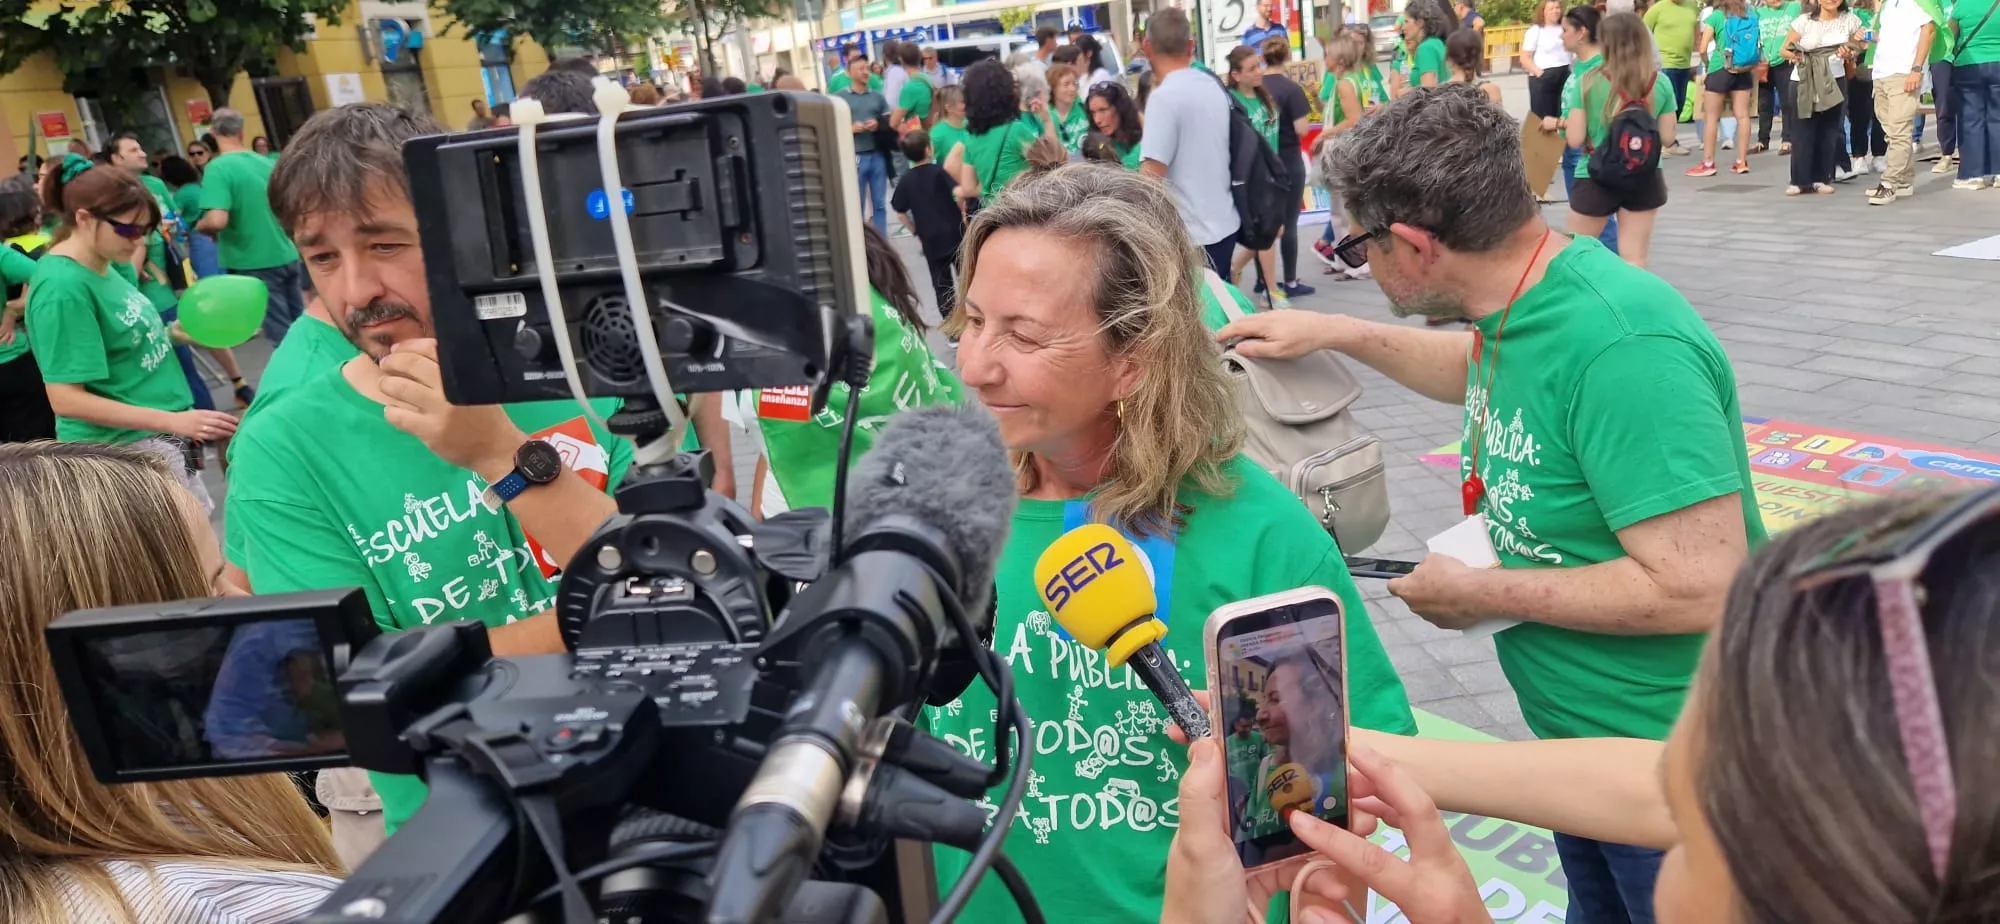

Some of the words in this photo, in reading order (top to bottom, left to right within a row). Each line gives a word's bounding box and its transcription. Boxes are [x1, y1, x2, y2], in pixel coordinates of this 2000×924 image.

[411, 576, 471, 625] DE
[1044, 541, 1126, 613] SER
[1008, 719, 1155, 767] OD@S
[1039, 793, 1181, 831] TOD@S
